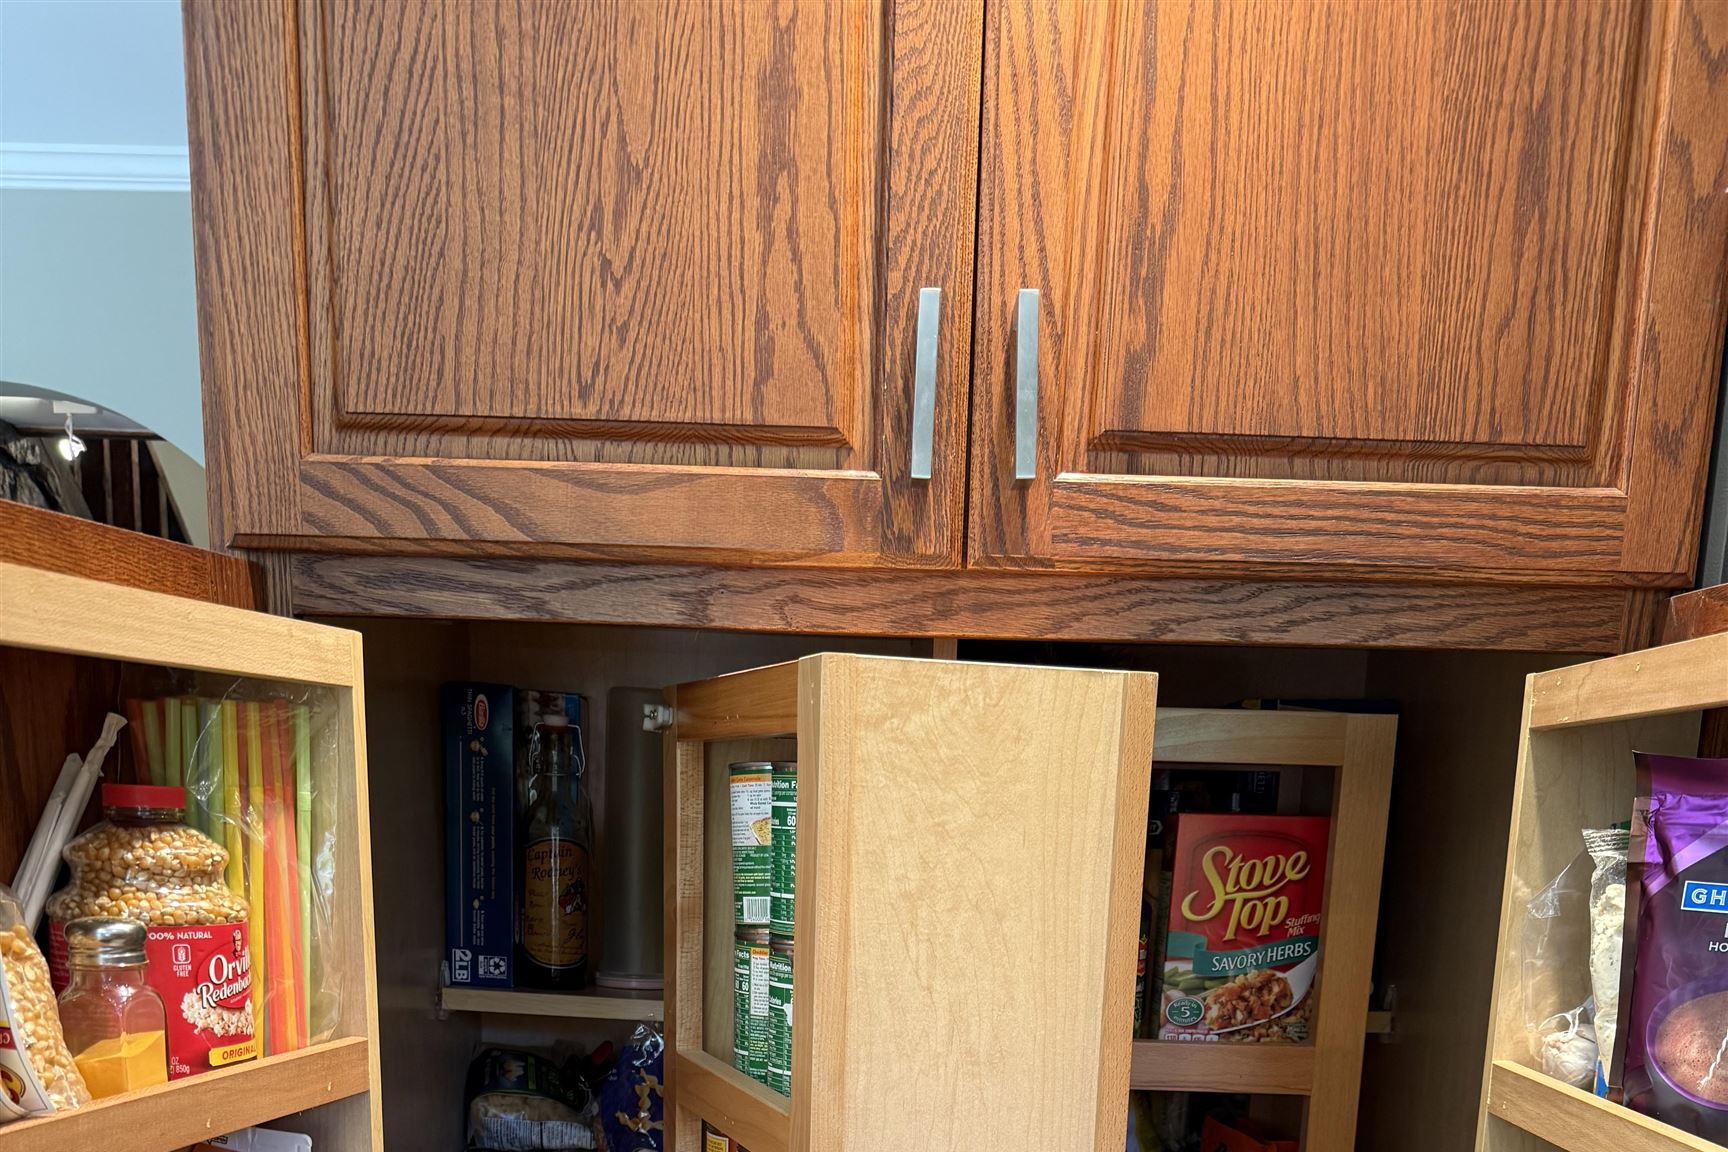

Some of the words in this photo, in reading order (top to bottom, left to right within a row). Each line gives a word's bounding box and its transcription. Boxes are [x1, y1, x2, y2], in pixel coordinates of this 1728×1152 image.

[1181, 845, 1311, 922] Stove
[1222, 892, 1289, 942] Top
[1284, 913, 1321, 928] Stuffing
[148, 931, 174, 940] 00%
[177, 931, 212, 940] NATURAL
[1287, 926, 1305, 938] Mix
[1211, 951, 1265, 972] SAVORY
[1267, 941, 1312, 963] HERBS
[173, 964, 192, 972] GLUTEN
[1181, 1006, 1191, 1018] 5
